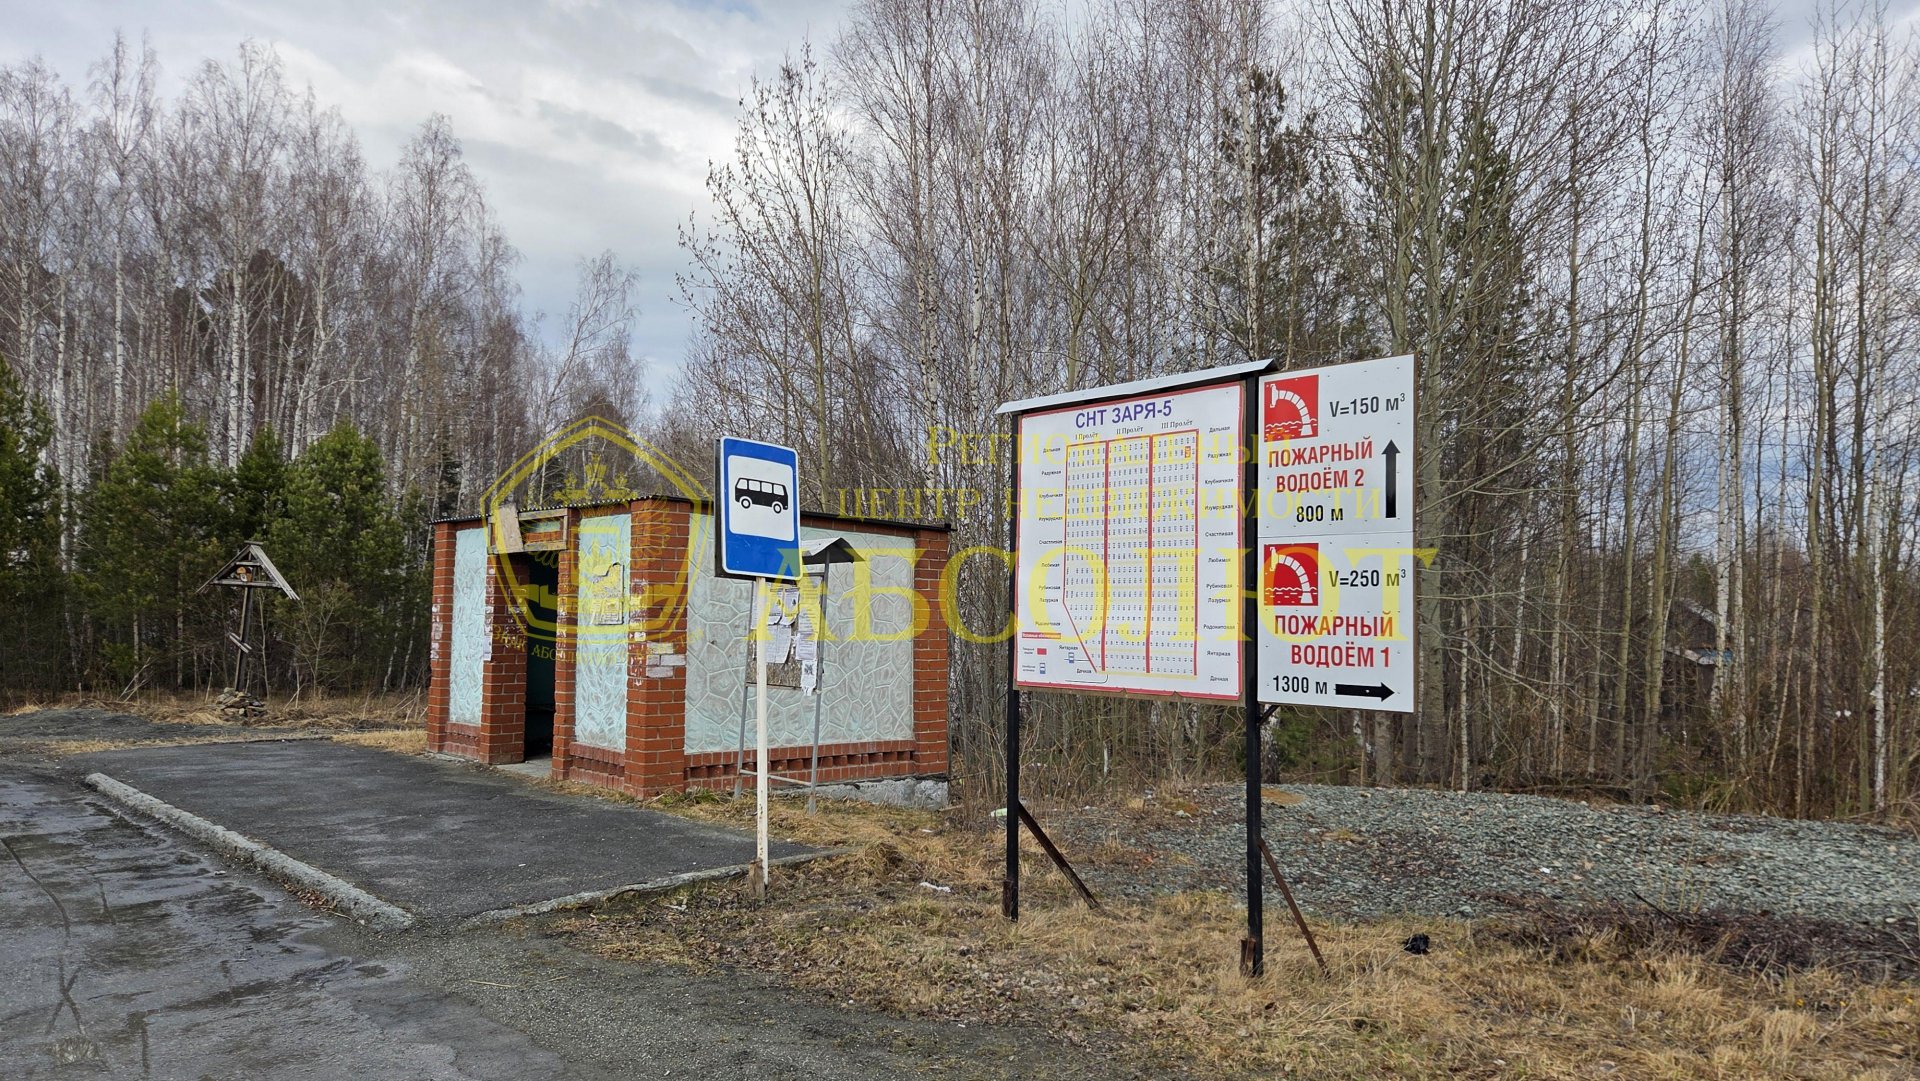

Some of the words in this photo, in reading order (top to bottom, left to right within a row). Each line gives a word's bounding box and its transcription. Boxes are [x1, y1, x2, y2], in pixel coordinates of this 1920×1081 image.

[1076, 409, 1107, 428] СНТ
[1111, 399, 1172, 424] ЗАРЯ-5
[1329, 396, 1379, 418] V=150
[1268, 436, 1374, 468] ПОЖАРНЫЙ
[1276, 467, 1349, 493] ВОДОЁМ
[1354, 468, 1365, 487] 2
[1296, 505, 1324, 522] 800
[1328, 570, 1380, 588] V=250
[1274, 610, 1393, 637] ПОЖАРНЫЙ
[1291, 641, 1374, 668] ВОДОЁМ
[1380, 646, 1390, 667] 1
[1272, 675, 1309, 694] 1300
[1315, 681, 1328, 695] м
